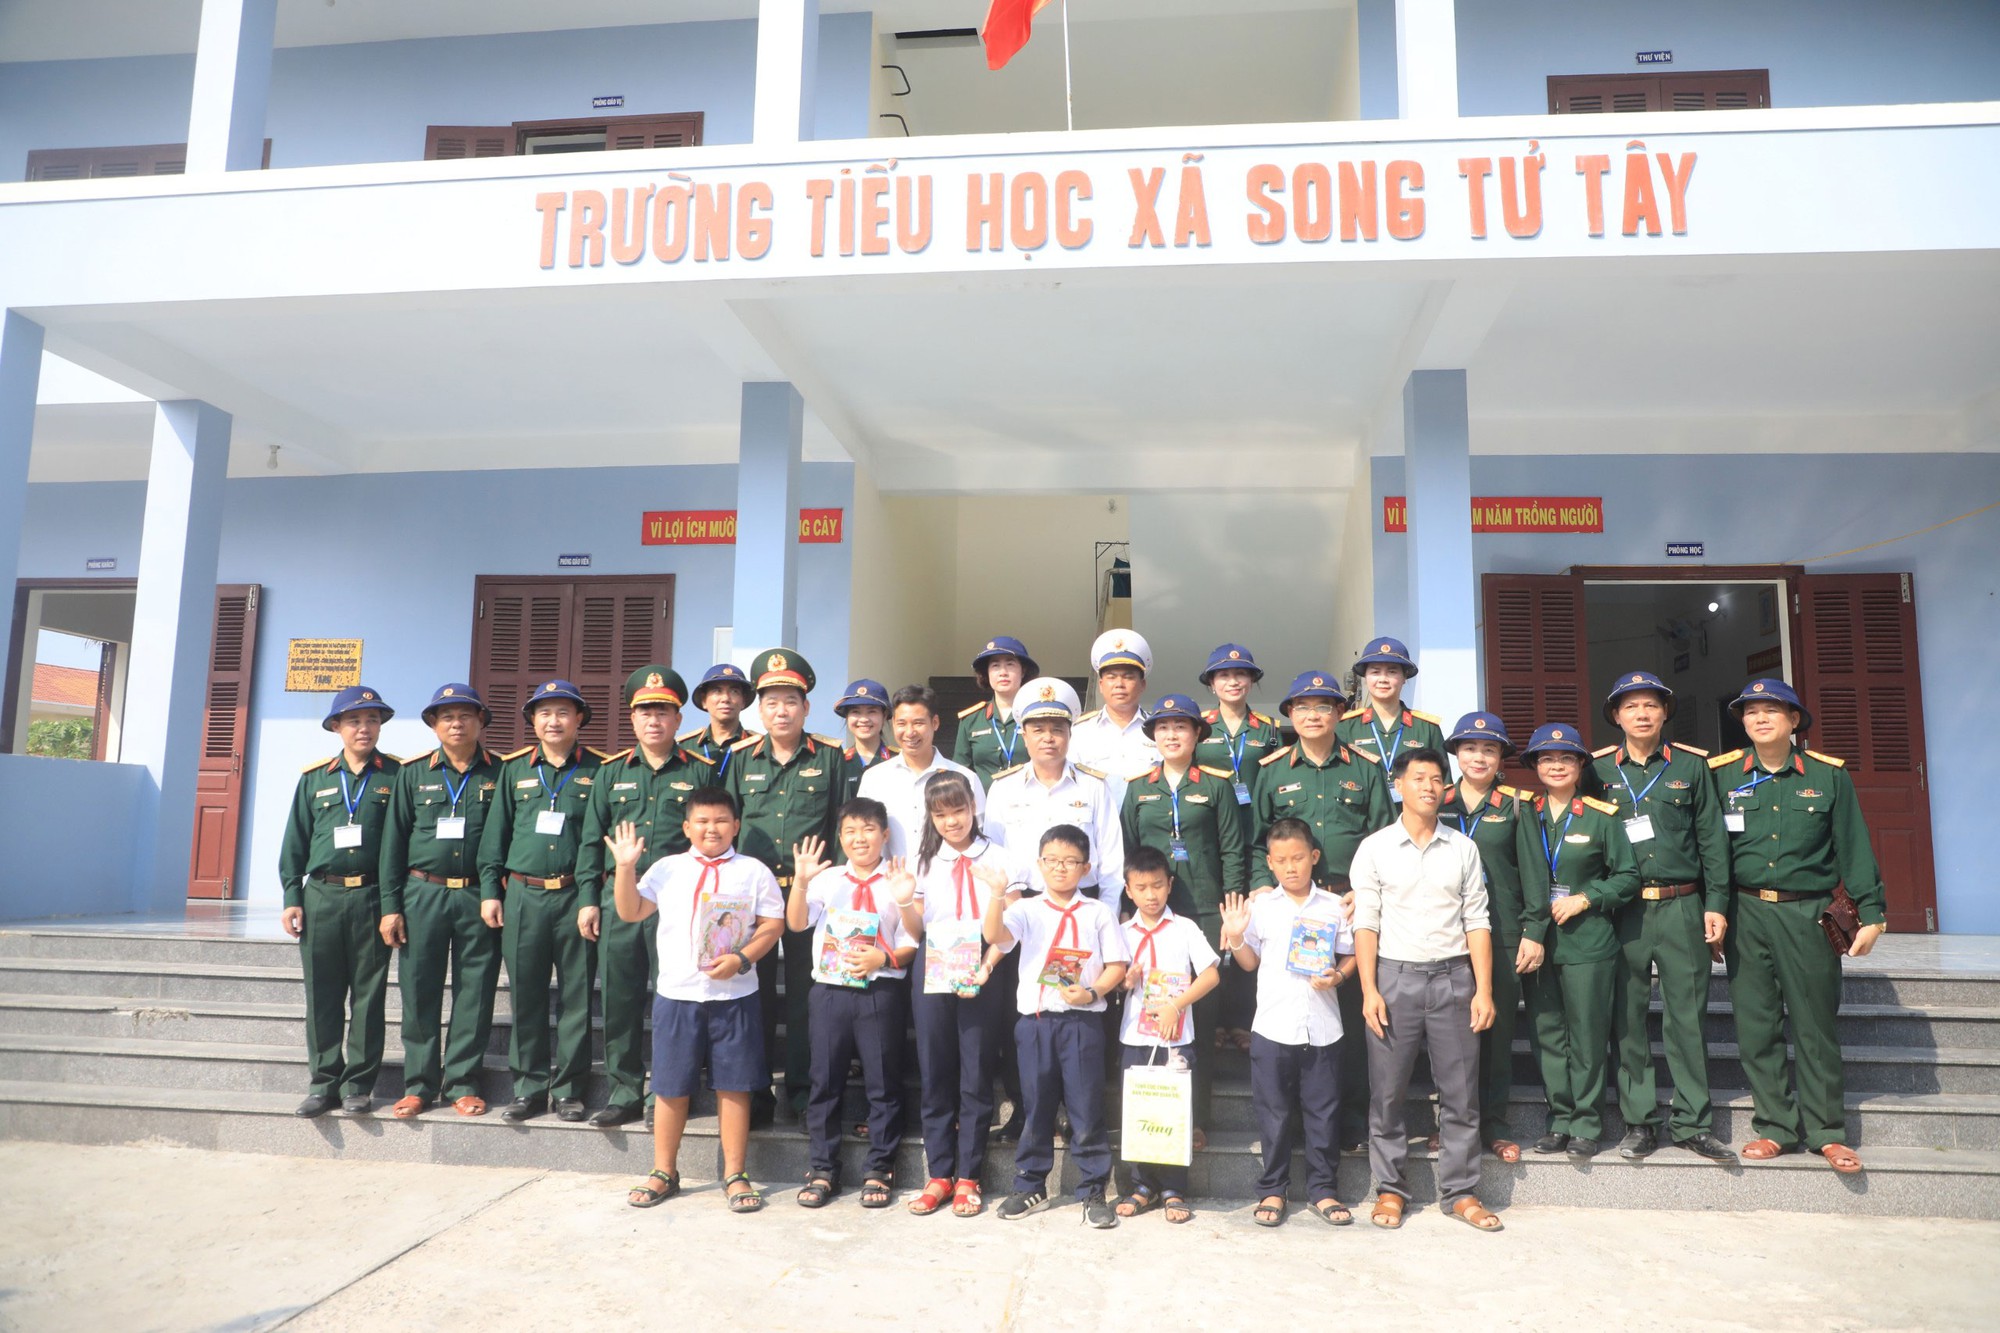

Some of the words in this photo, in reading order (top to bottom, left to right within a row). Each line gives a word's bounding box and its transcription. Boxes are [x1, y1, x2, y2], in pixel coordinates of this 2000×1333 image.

[1638, 53, 1653, 62] THƯ
[1653, 51, 1671, 62] VIỆN
[535, 172, 774, 269] TRƯỜNG
[966, 170, 1094, 261] HỌC
[1127, 153, 1213, 248] XÃ
[1246, 159, 1425, 244] SONG
[1458, 140, 1547, 240] TỬ
[1575, 139, 1698, 237] TÂY
[1387, 502, 1399, 525] VÌ
[1485, 503, 1512, 526] NĂM
[1515, 500, 1556, 526] TRỒNG
[1560, 502, 1598, 526] NGƯỜI
[650, 517, 663, 538] VÌ
[665, 518, 683, 543] LỢI
[686, 516, 706, 538] ÍCH
[813, 515, 838, 536] CÂY
[1668, 545, 1688, 554] PHÒNG
[1689, 547, 1702, 555] HỌC
